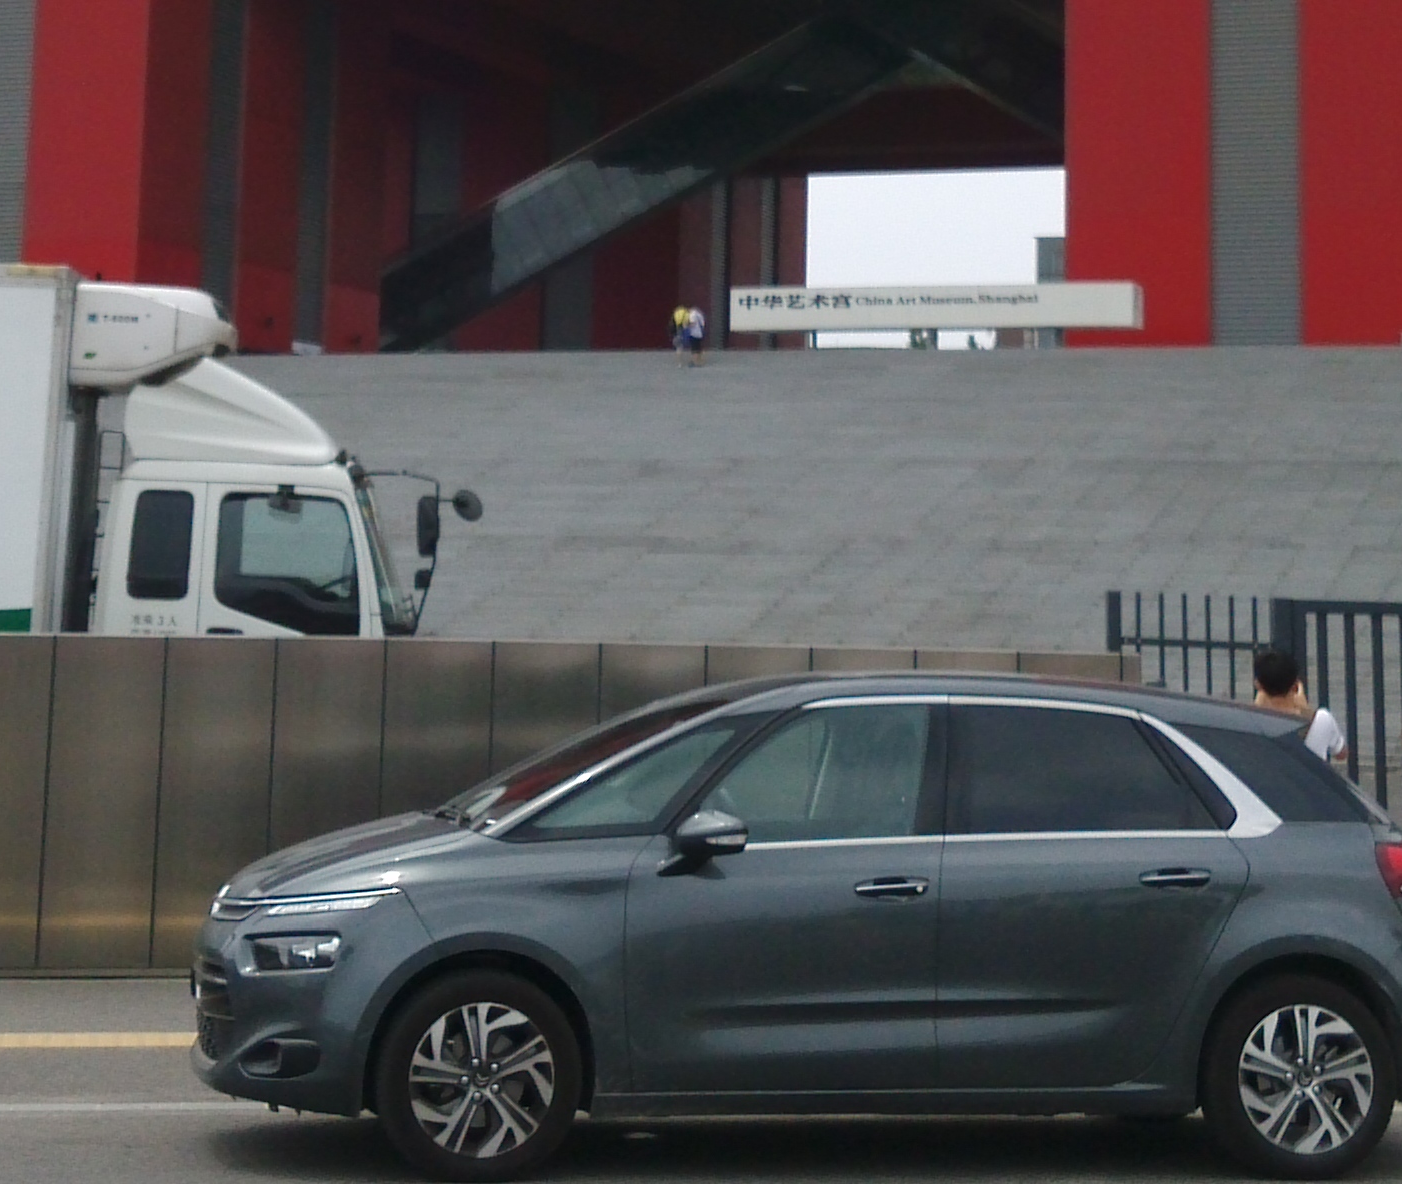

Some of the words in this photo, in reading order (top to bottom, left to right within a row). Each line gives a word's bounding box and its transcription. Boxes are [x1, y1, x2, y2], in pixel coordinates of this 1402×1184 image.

[738, 294, 853, 310] 中华艺术宫
[856, 296, 893, 307] China
[896, 295, 917, 306] Art
